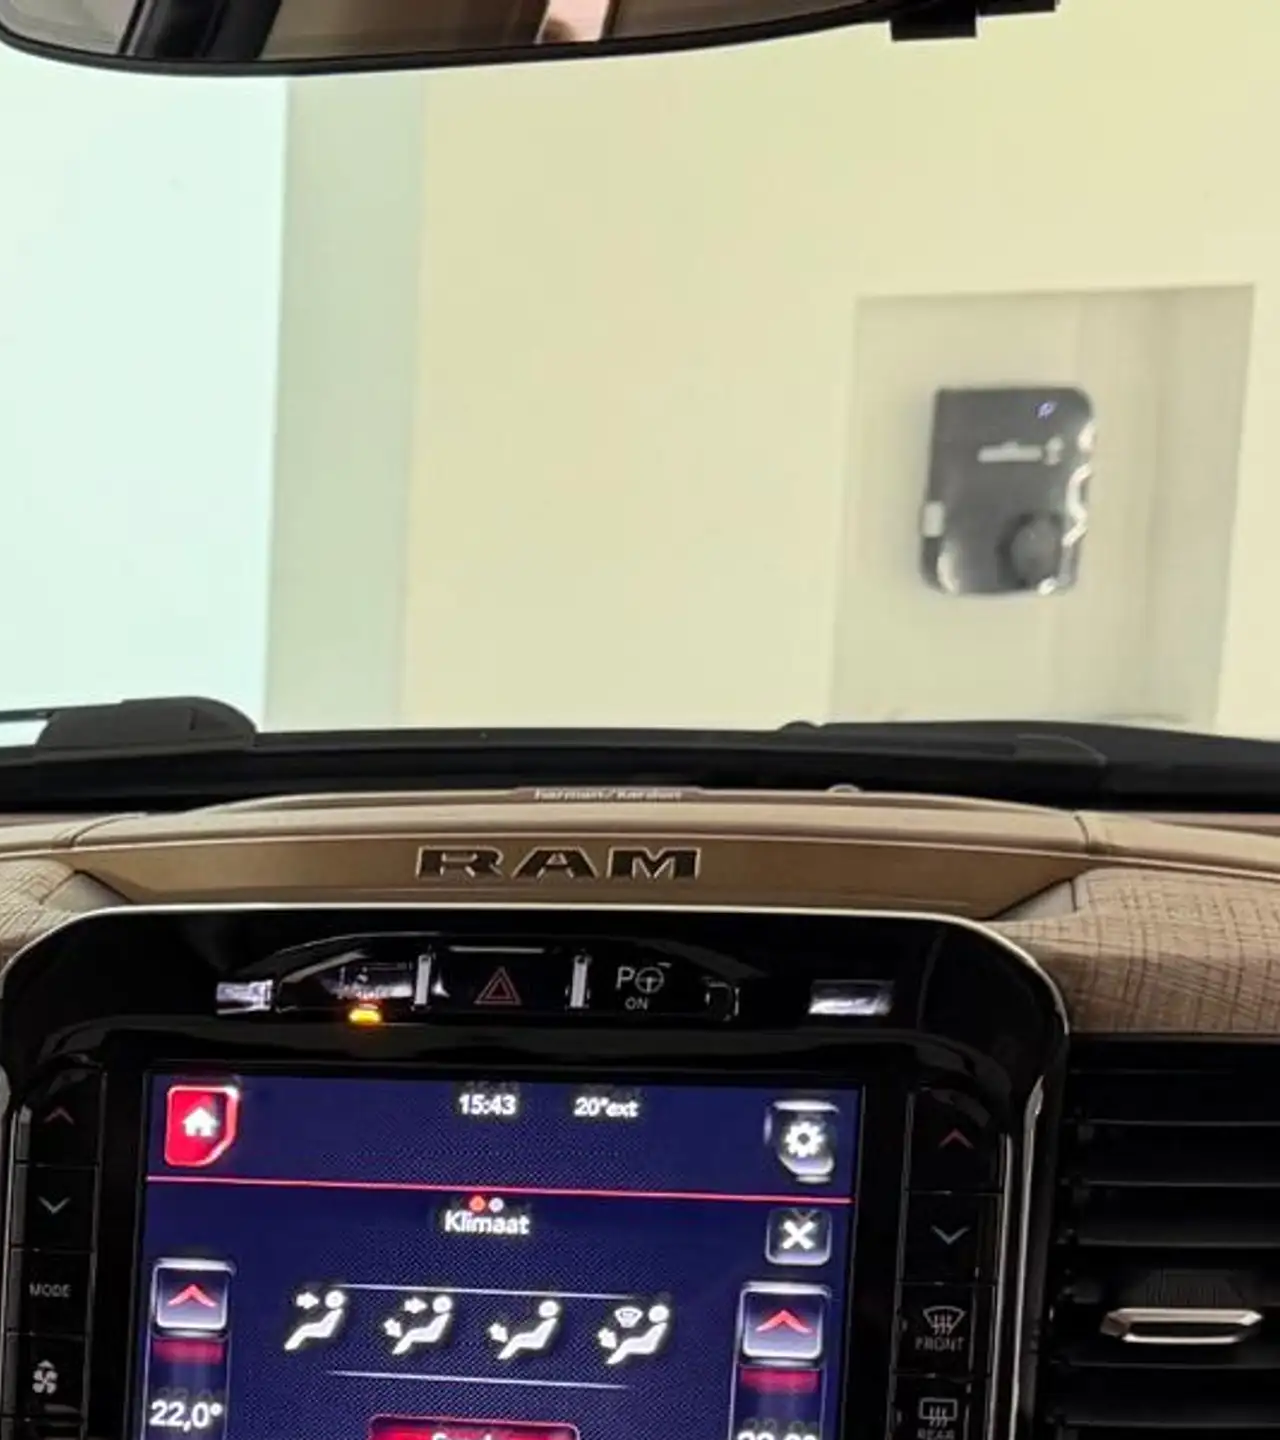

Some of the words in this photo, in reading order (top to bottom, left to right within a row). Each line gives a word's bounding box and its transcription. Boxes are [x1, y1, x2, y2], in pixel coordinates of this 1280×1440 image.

[415, 845, 703, 880] RAM
[458, 1093, 517, 1116] 15:43
[443, 1209, 531, 1236] Klimaat
[29, 1282, 72, 1298] MODE
[914, 1336, 965, 1351] FRONT
[148, 1399, 224, 1432] 22,0°
